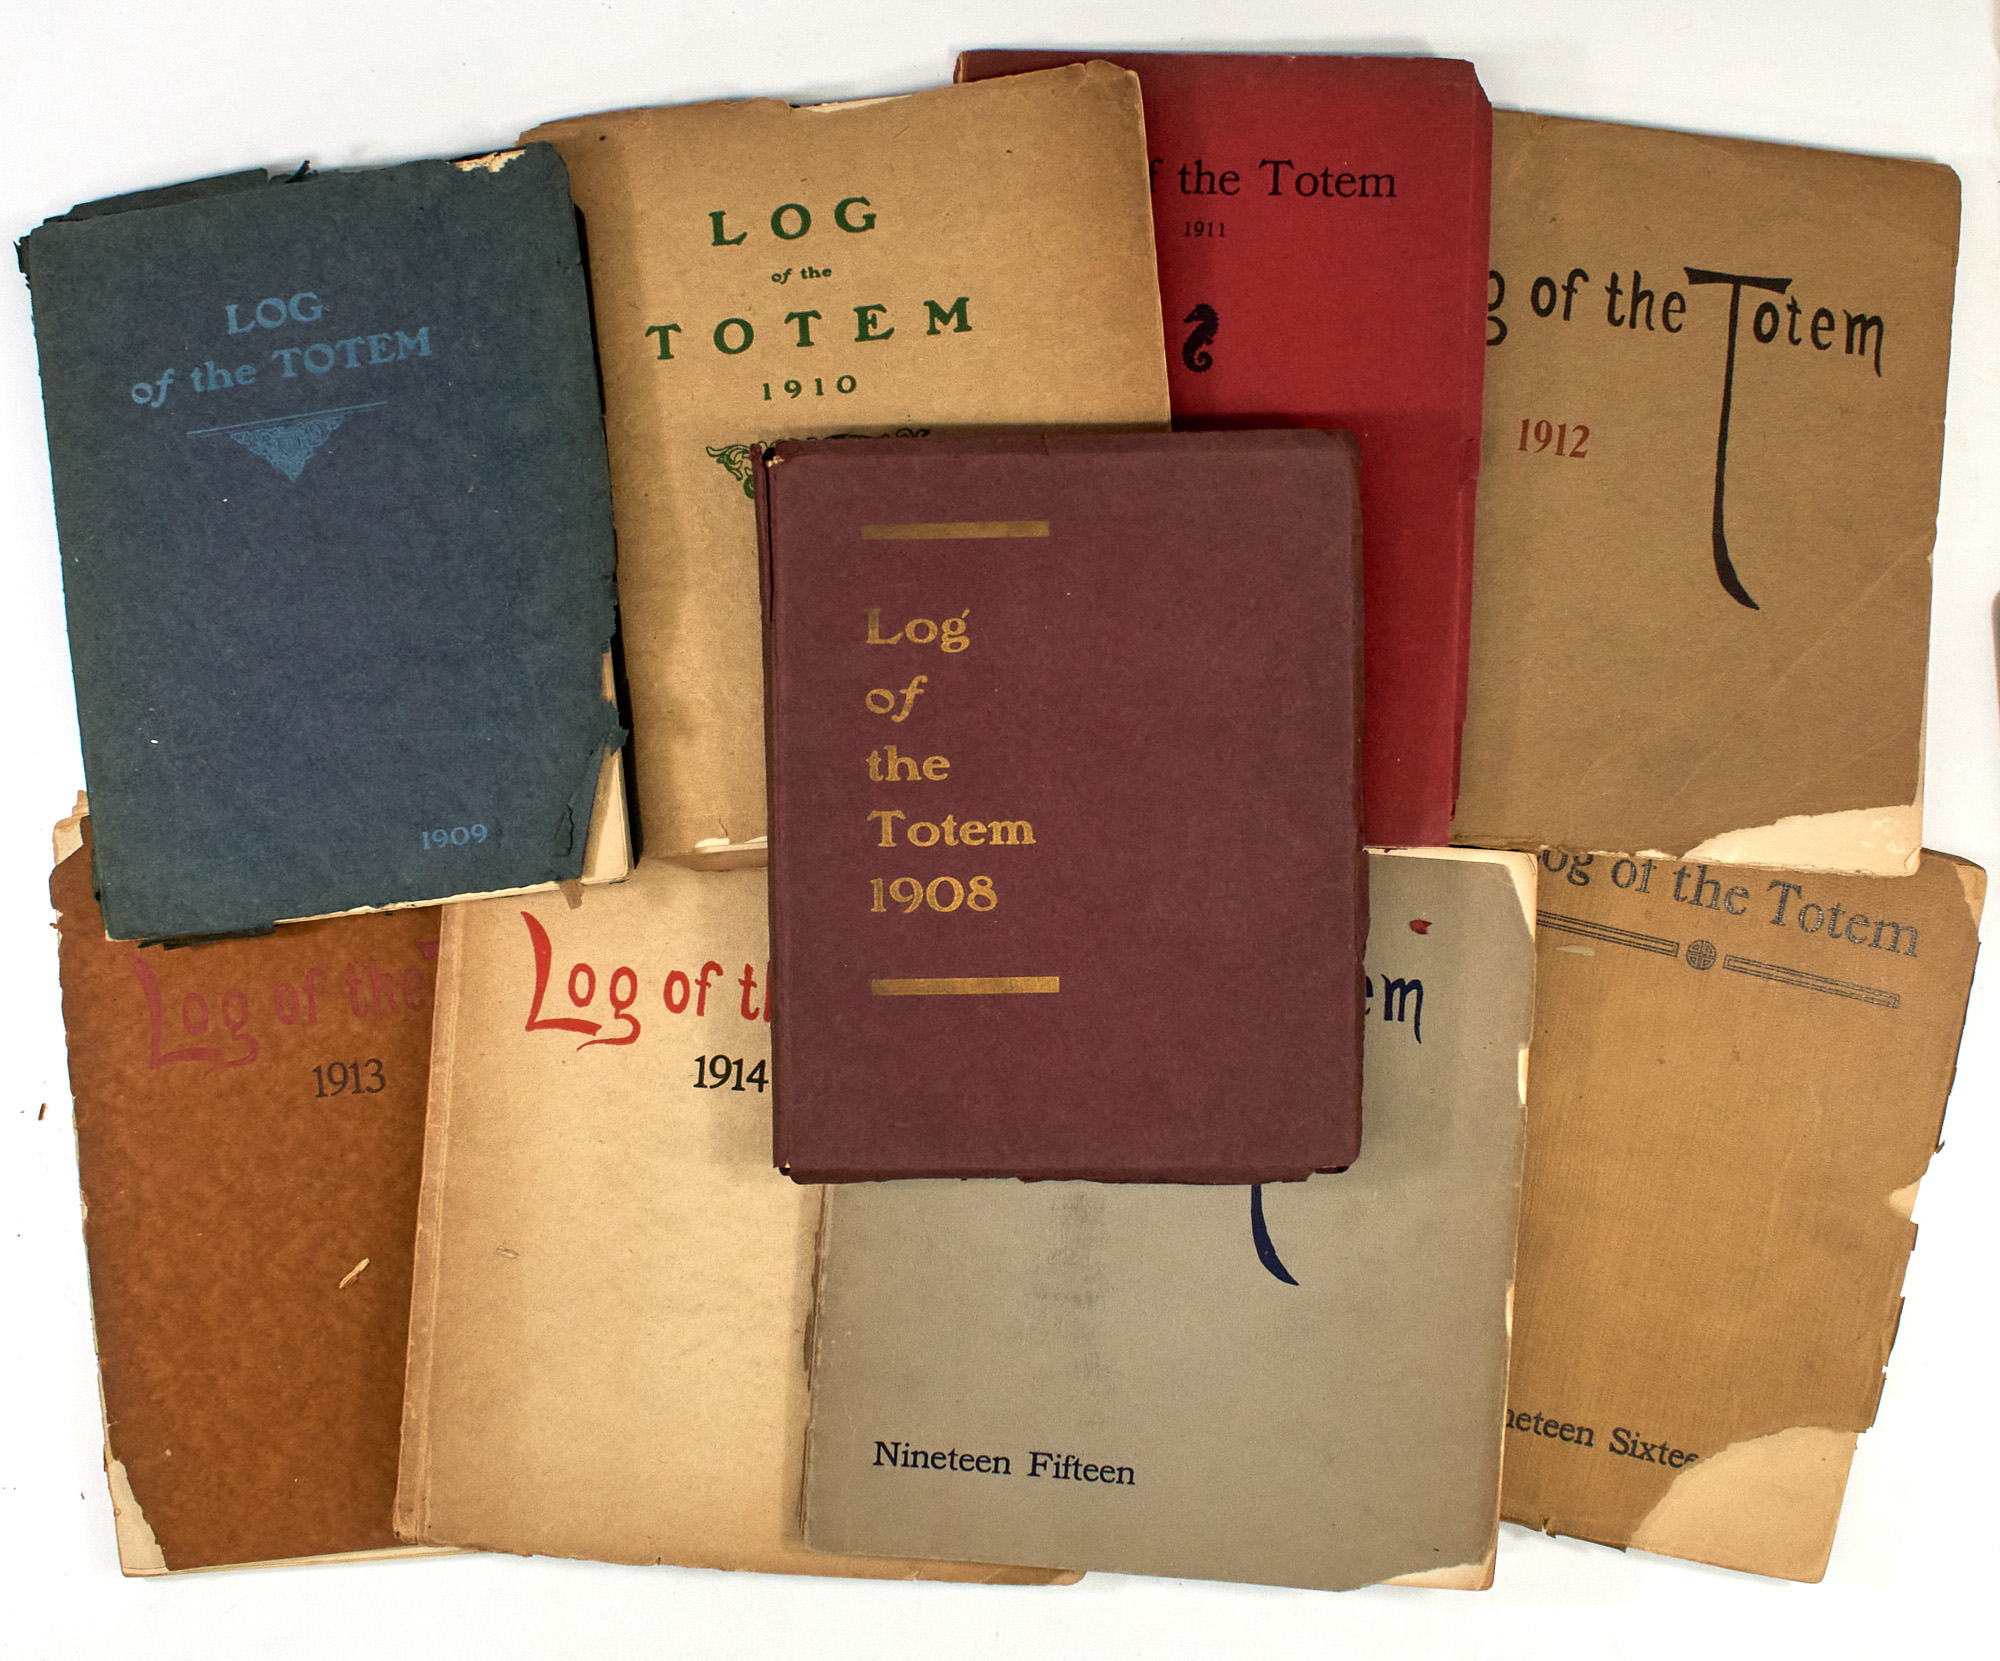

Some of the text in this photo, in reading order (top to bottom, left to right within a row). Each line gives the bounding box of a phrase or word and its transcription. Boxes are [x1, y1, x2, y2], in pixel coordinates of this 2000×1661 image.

[1178, 159, 1241, 196] the
[1258, 158, 1398, 198] Totem
[707, 196, 877, 247] LOG
[1183, 220, 1226, 238] 1911
[770, 266, 833, 285] of the
[225, 291, 325, 335] LOG
[644, 295, 974, 361] TOTEM
[131, 326, 434, 409] of the TOTEM
[761, 373, 858, 401] 1910
[1517, 418, 1591, 459] 1912
[1530, 267, 1590, 321] of
[1604, 269, 1687, 334] the
[1683, 265, 1885, 611] Totem
[865, 607, 971, 654] Log
[865, 674, 928, 723] of
[865, 744, 951, 782] the
[421, 823, 489, 851] 1909
[866, 809, 1037, 848] Totem
[869, 874, 998, 914] 1908
[1537, 850, 1594, 887] og
[1672, 863, 1750, 916] the
[1766, 878, 1918, 958] Totem
[520, 910, 642, 1052] Log
[662, 960, 724, 1018] of
[126, 953, 428, 1079] Log of the
[311, 1057, 387, 1099] 1913
[693, 1054, 769, 1093] 1914
[872, 1440, 1136, 1486] Nineteen Fifteen
